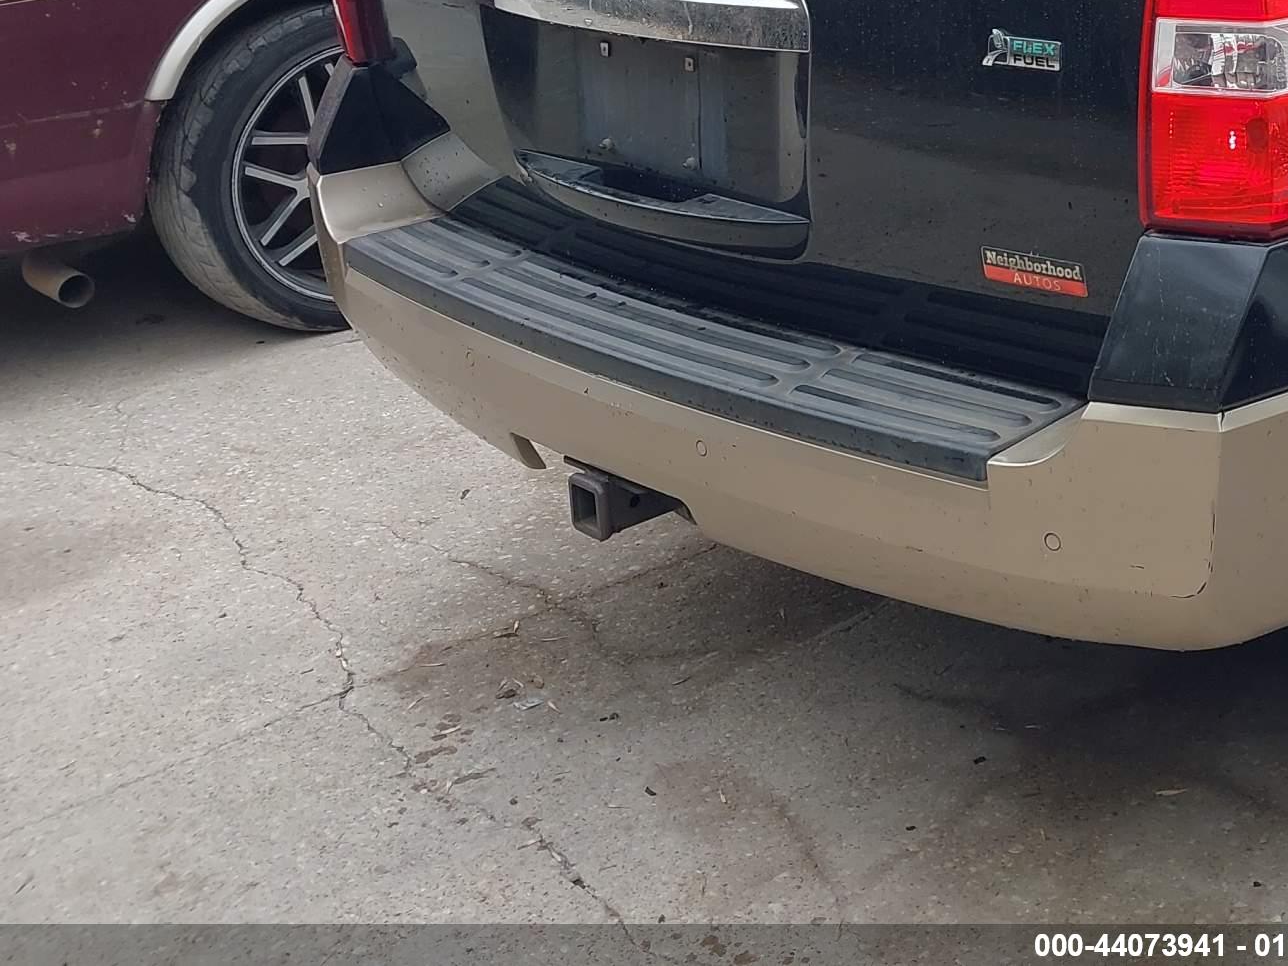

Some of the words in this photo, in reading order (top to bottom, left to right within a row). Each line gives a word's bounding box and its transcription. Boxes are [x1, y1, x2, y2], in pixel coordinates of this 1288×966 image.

[1013, 40, 1056, 55] FLEX
[1013, 54, 1056, 69] FUEL
[984, 250, 1082, 281] Neighborhood
[1013, 273, 1061, 291] AUTOS
